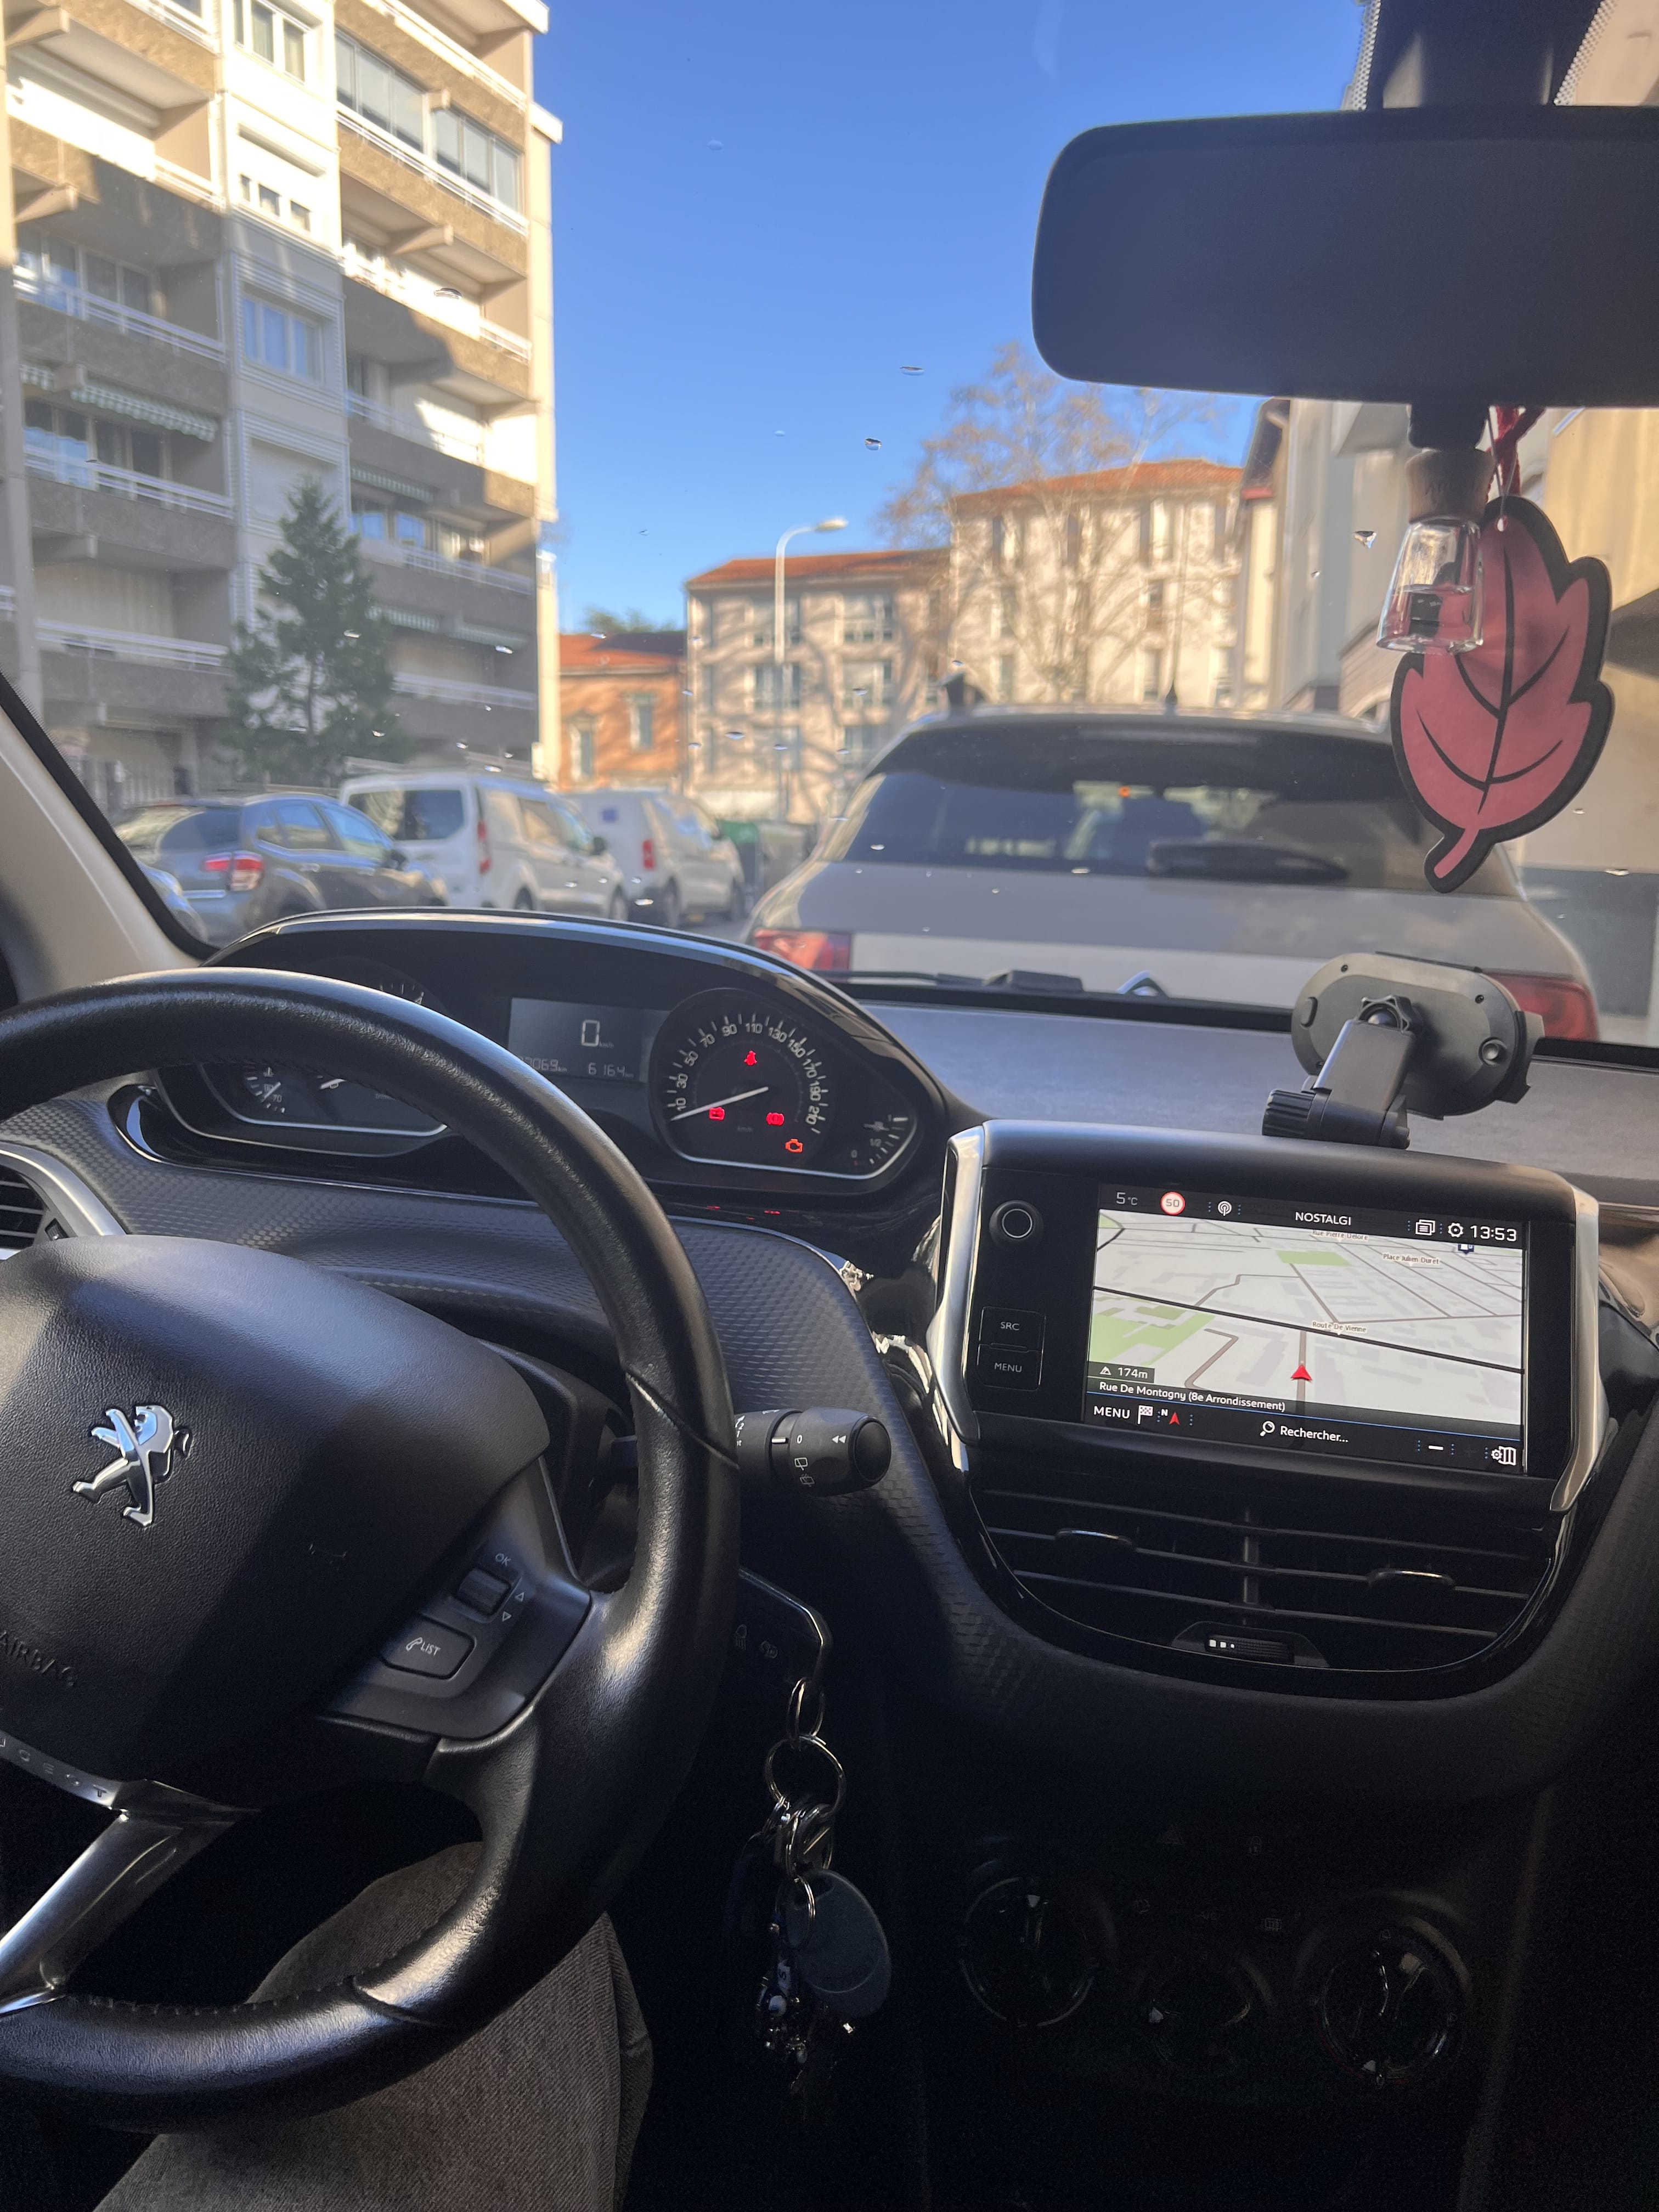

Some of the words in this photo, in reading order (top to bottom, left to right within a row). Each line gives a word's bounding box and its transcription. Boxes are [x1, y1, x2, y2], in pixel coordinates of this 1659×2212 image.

[582, 1019, 600, 1047] 0
[721, 1023, 737, 1036] 90
[746, 1023, 763, 1034] 110
[769, 1027, 787, 1042] 130
[700, 1034, 715, 1048] 70
[788, 1039, 805, 1058] 150
[684, 1051, 698, 1066] 50
[803, 1059, 817, 1078] 170
[676, 1073, 688, 1088] 30
[810, 1080, 821, 1101] 190
[675, 1097, 686, 1111] 10
[806, 1105, 820, 1125] 210
[1295, 1212, 1351, 1225] NOSTALGI
[1470, 1225, 1517, 1242] 13:53
[1000, 1322, 1020, 1331] SRC
[994, 1362, 1022, 1373] MENU
[1118, 1367, 1148, 1379] 174m
[1099, 1381, 1118, 1391] Rue
[1120, 1384, 1134, 1394] De
[1136, 1386, 1186, 1402] Montagny
[1188, 1392, 1204, 1402] (8e
[1205, 1394, 1286, 1413] Arrondissement)
[1094, 1406, 1130, 1419] MENU
[1280, 1426, 1348, 1443] Rechercher...
[495, 1553, 511, 1567] OK
[421, 1641, 441, 1656] LIST
